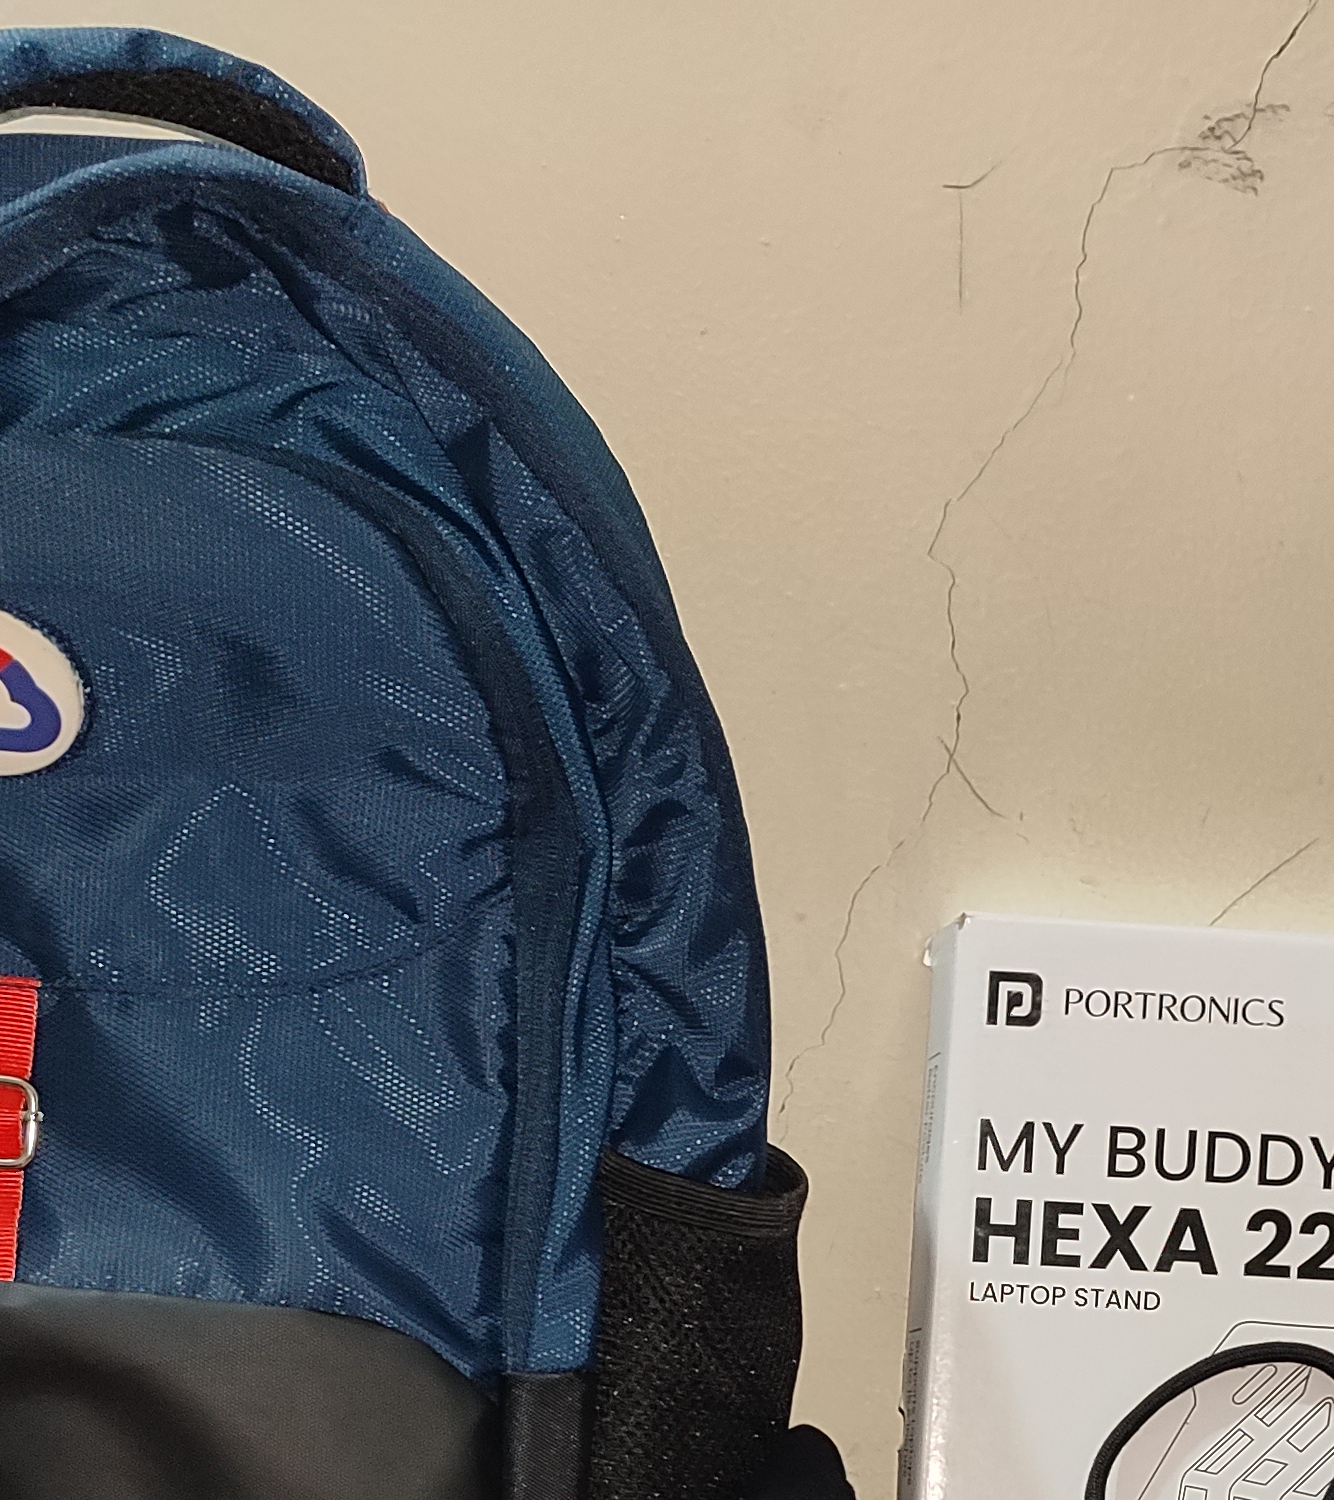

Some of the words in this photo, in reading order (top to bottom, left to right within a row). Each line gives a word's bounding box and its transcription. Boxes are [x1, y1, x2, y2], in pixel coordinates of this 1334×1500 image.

[1064, 988, 1285, 1027] PORTRONICS
[977, 1118, 1084, 1175] MY
[972, 1197, 1218, 1275] HEXA
[969, 1282, 1066, 1305] LAPTOP
[1074, 1287, 1161, 1311] STAND
